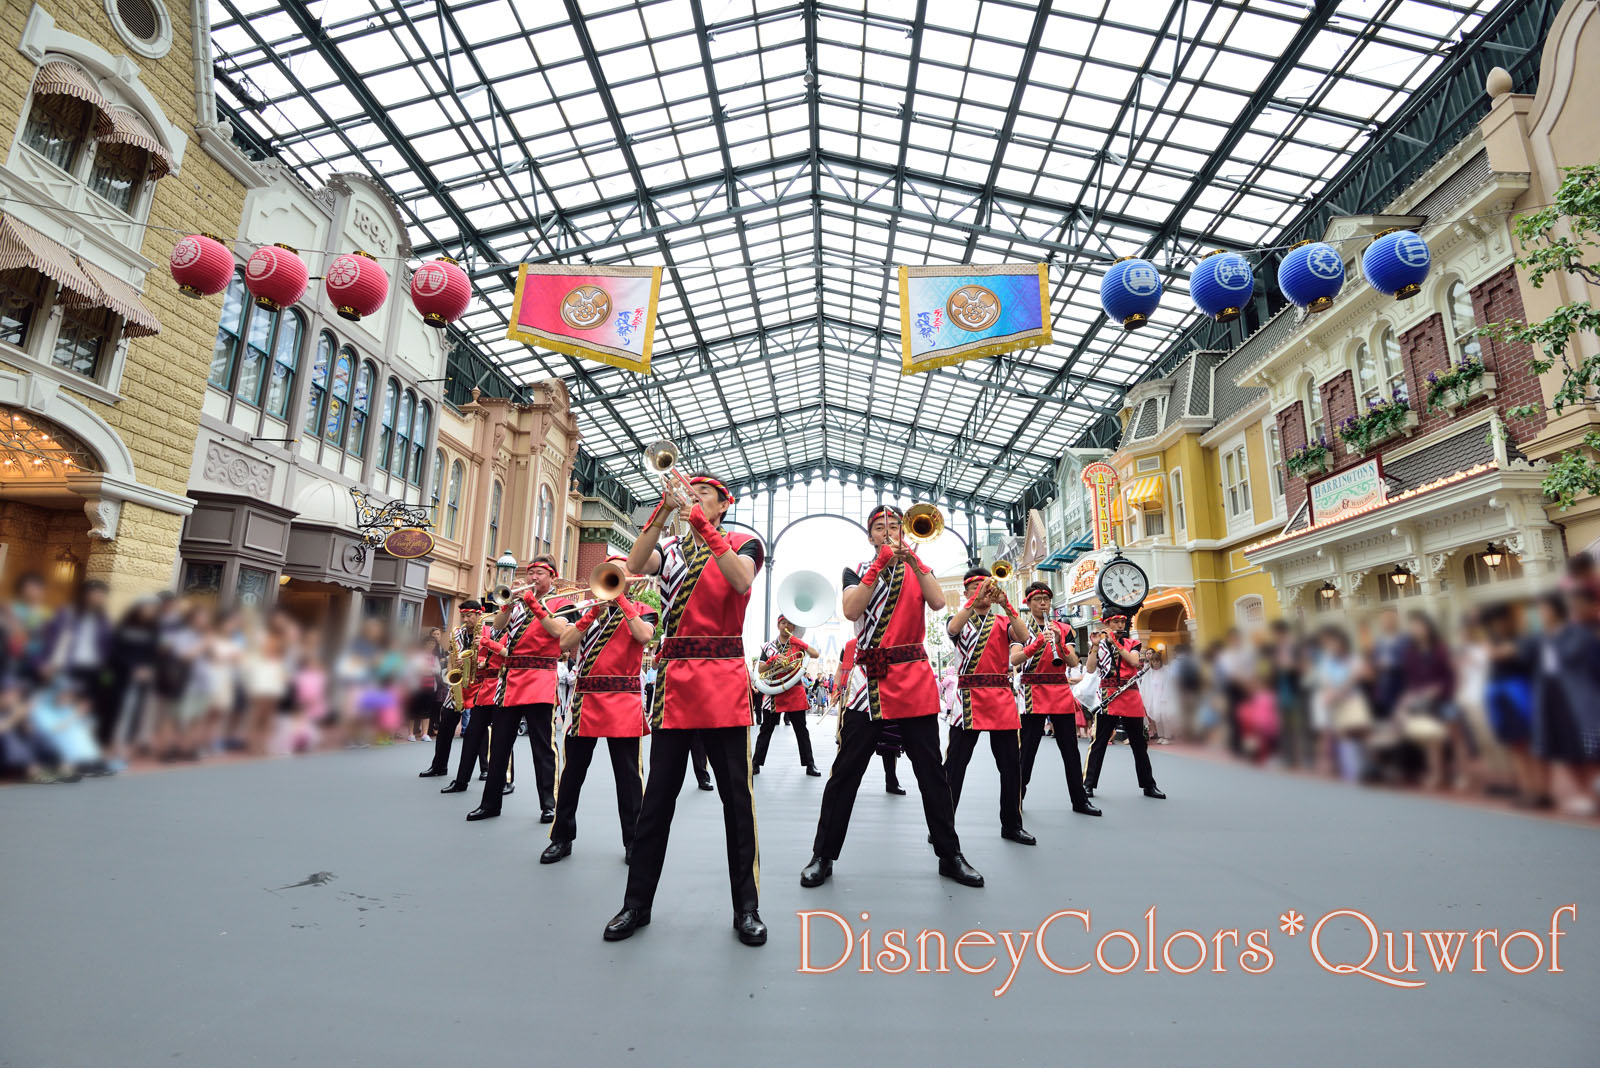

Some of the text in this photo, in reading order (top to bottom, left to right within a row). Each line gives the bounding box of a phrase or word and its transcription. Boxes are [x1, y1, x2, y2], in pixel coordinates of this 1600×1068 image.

[353, 207, 388, 254] 1894
[1089, 465, 1112, 476] PENNY
[1098, 473, 1109, 545] ARCADE
[1342, 498, 1350, 509] &
[1076, 559, 1100, 579] PENNY
